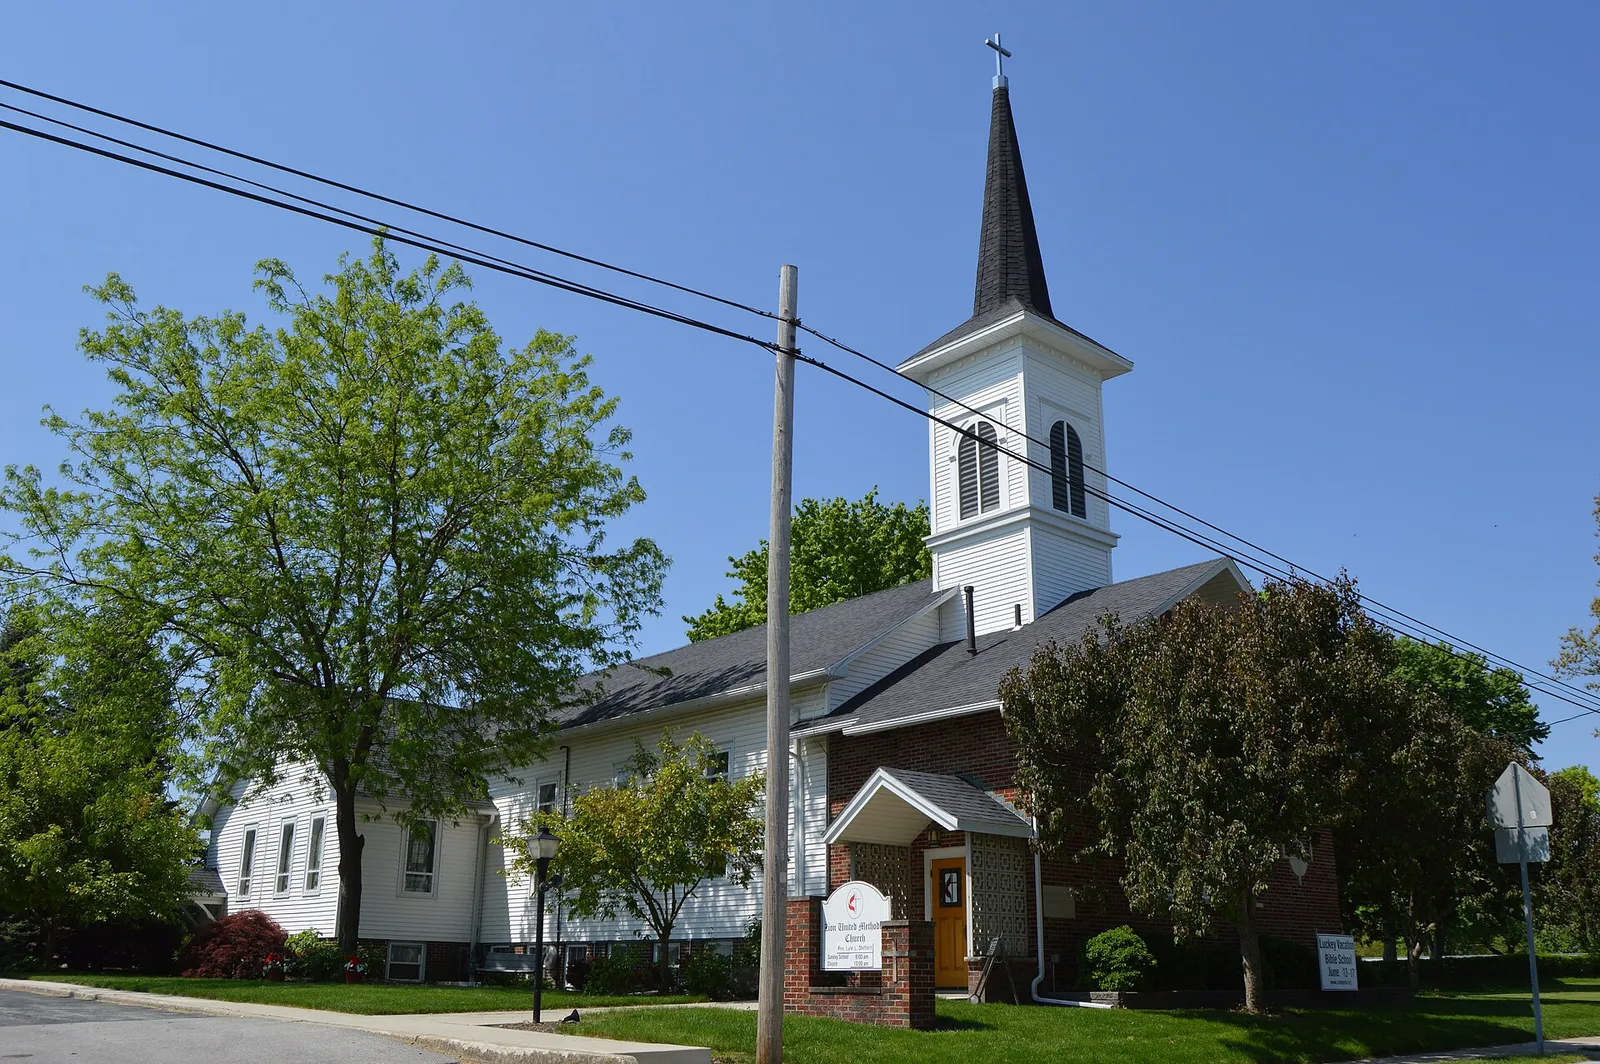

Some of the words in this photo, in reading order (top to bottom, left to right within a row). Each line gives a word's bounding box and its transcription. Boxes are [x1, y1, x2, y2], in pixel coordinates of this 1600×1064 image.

[838, 922, 857, 931] United
[858, 922, 881, 931] Method
[845, 933, 866, 943] Church
[1319, 939, 1336, 951] Luckey
[1336, 940, 1354, 950] Vacation
[1325, 953, 1338, 964] Bible
[1337, 954, 1353, 965] School
[1328, 966, 1340, 977] June
